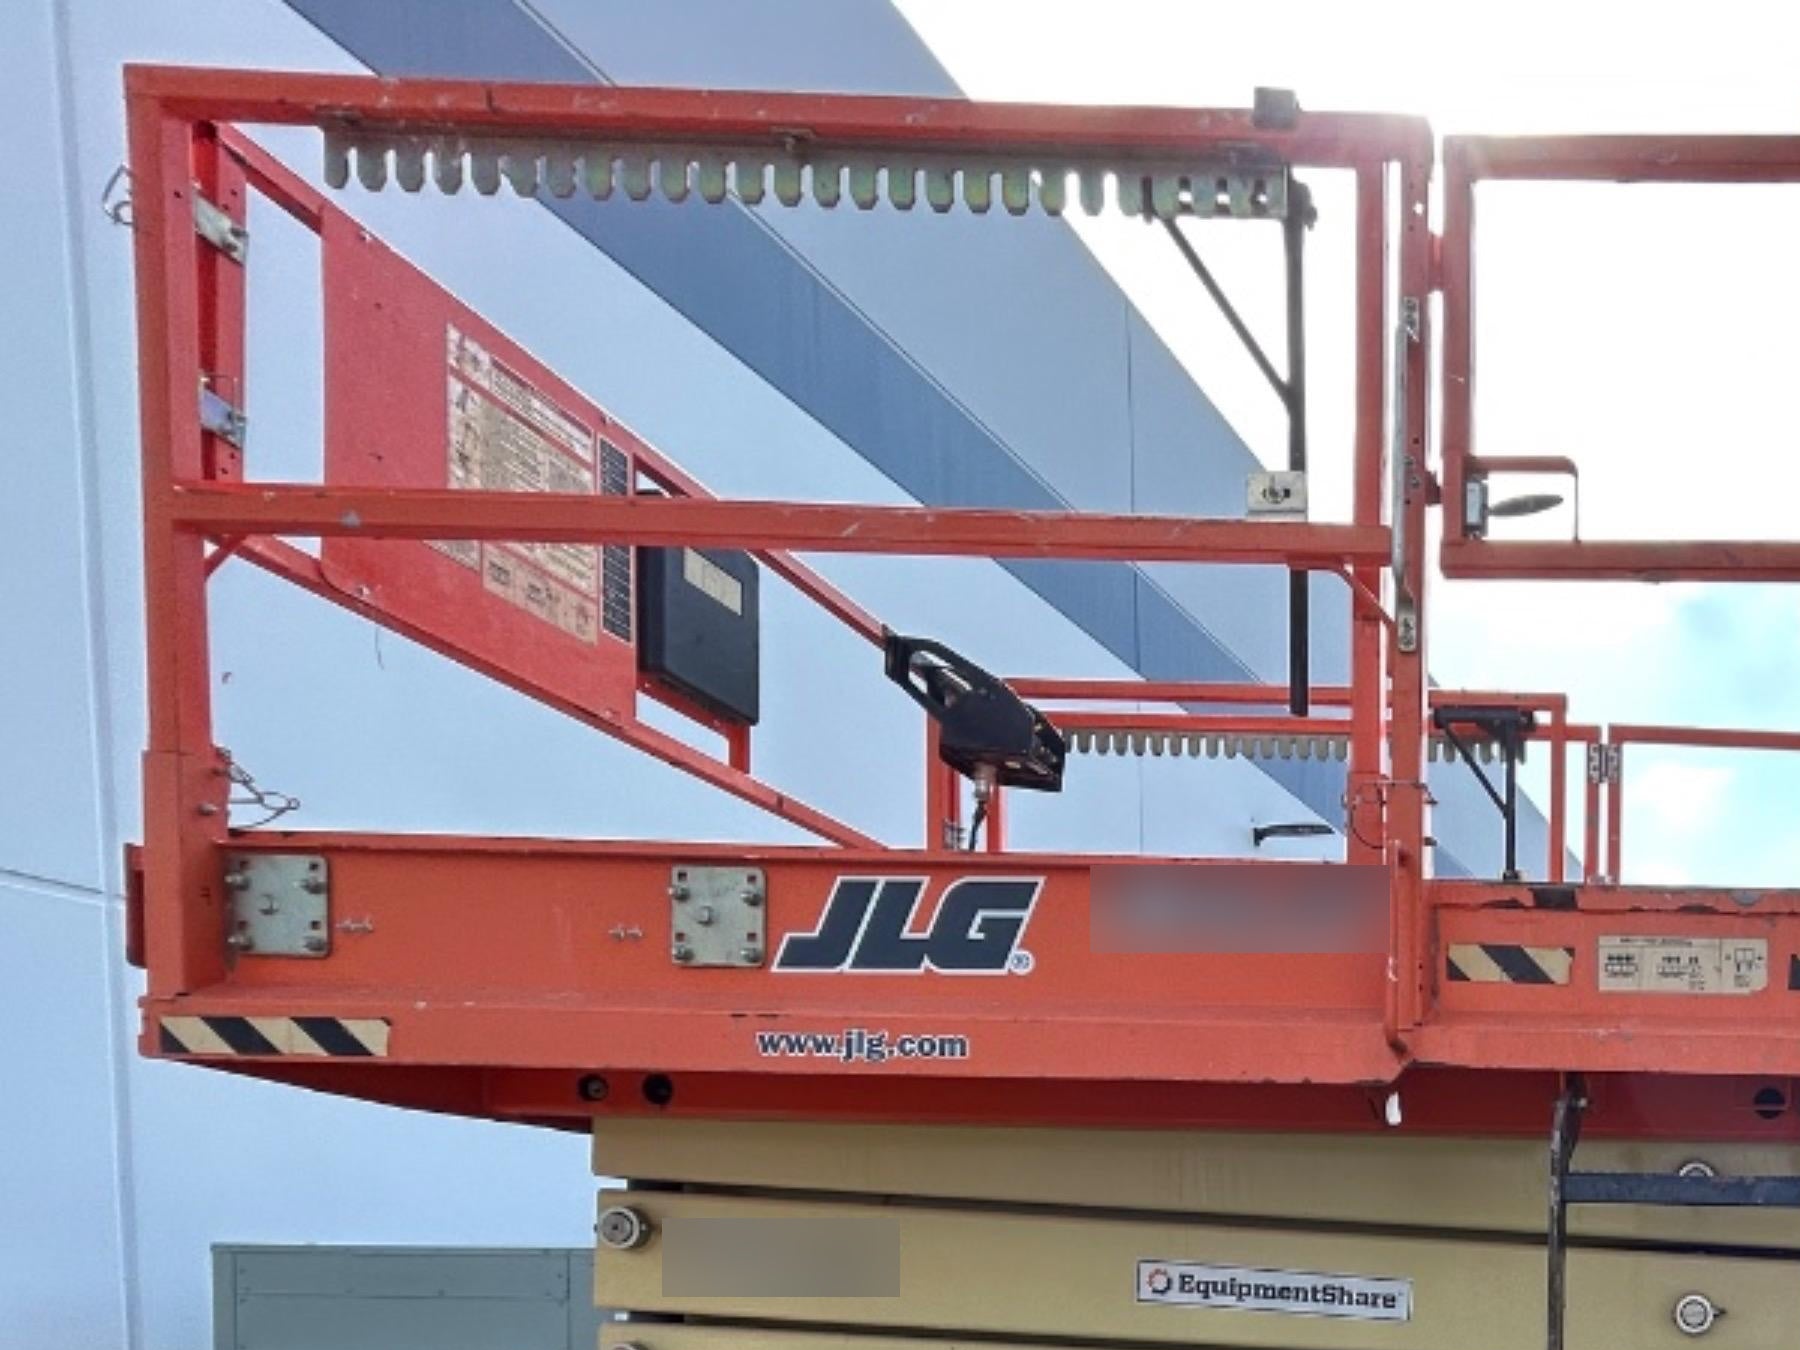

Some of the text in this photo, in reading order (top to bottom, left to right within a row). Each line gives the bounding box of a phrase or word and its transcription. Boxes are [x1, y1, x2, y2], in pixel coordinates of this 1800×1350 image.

[770, 876, 1045, 974] JLG
[756, 1029, 968, 1062] www.jlg.com
[1177, 1273, 1397, 1309] EquipmentShare
